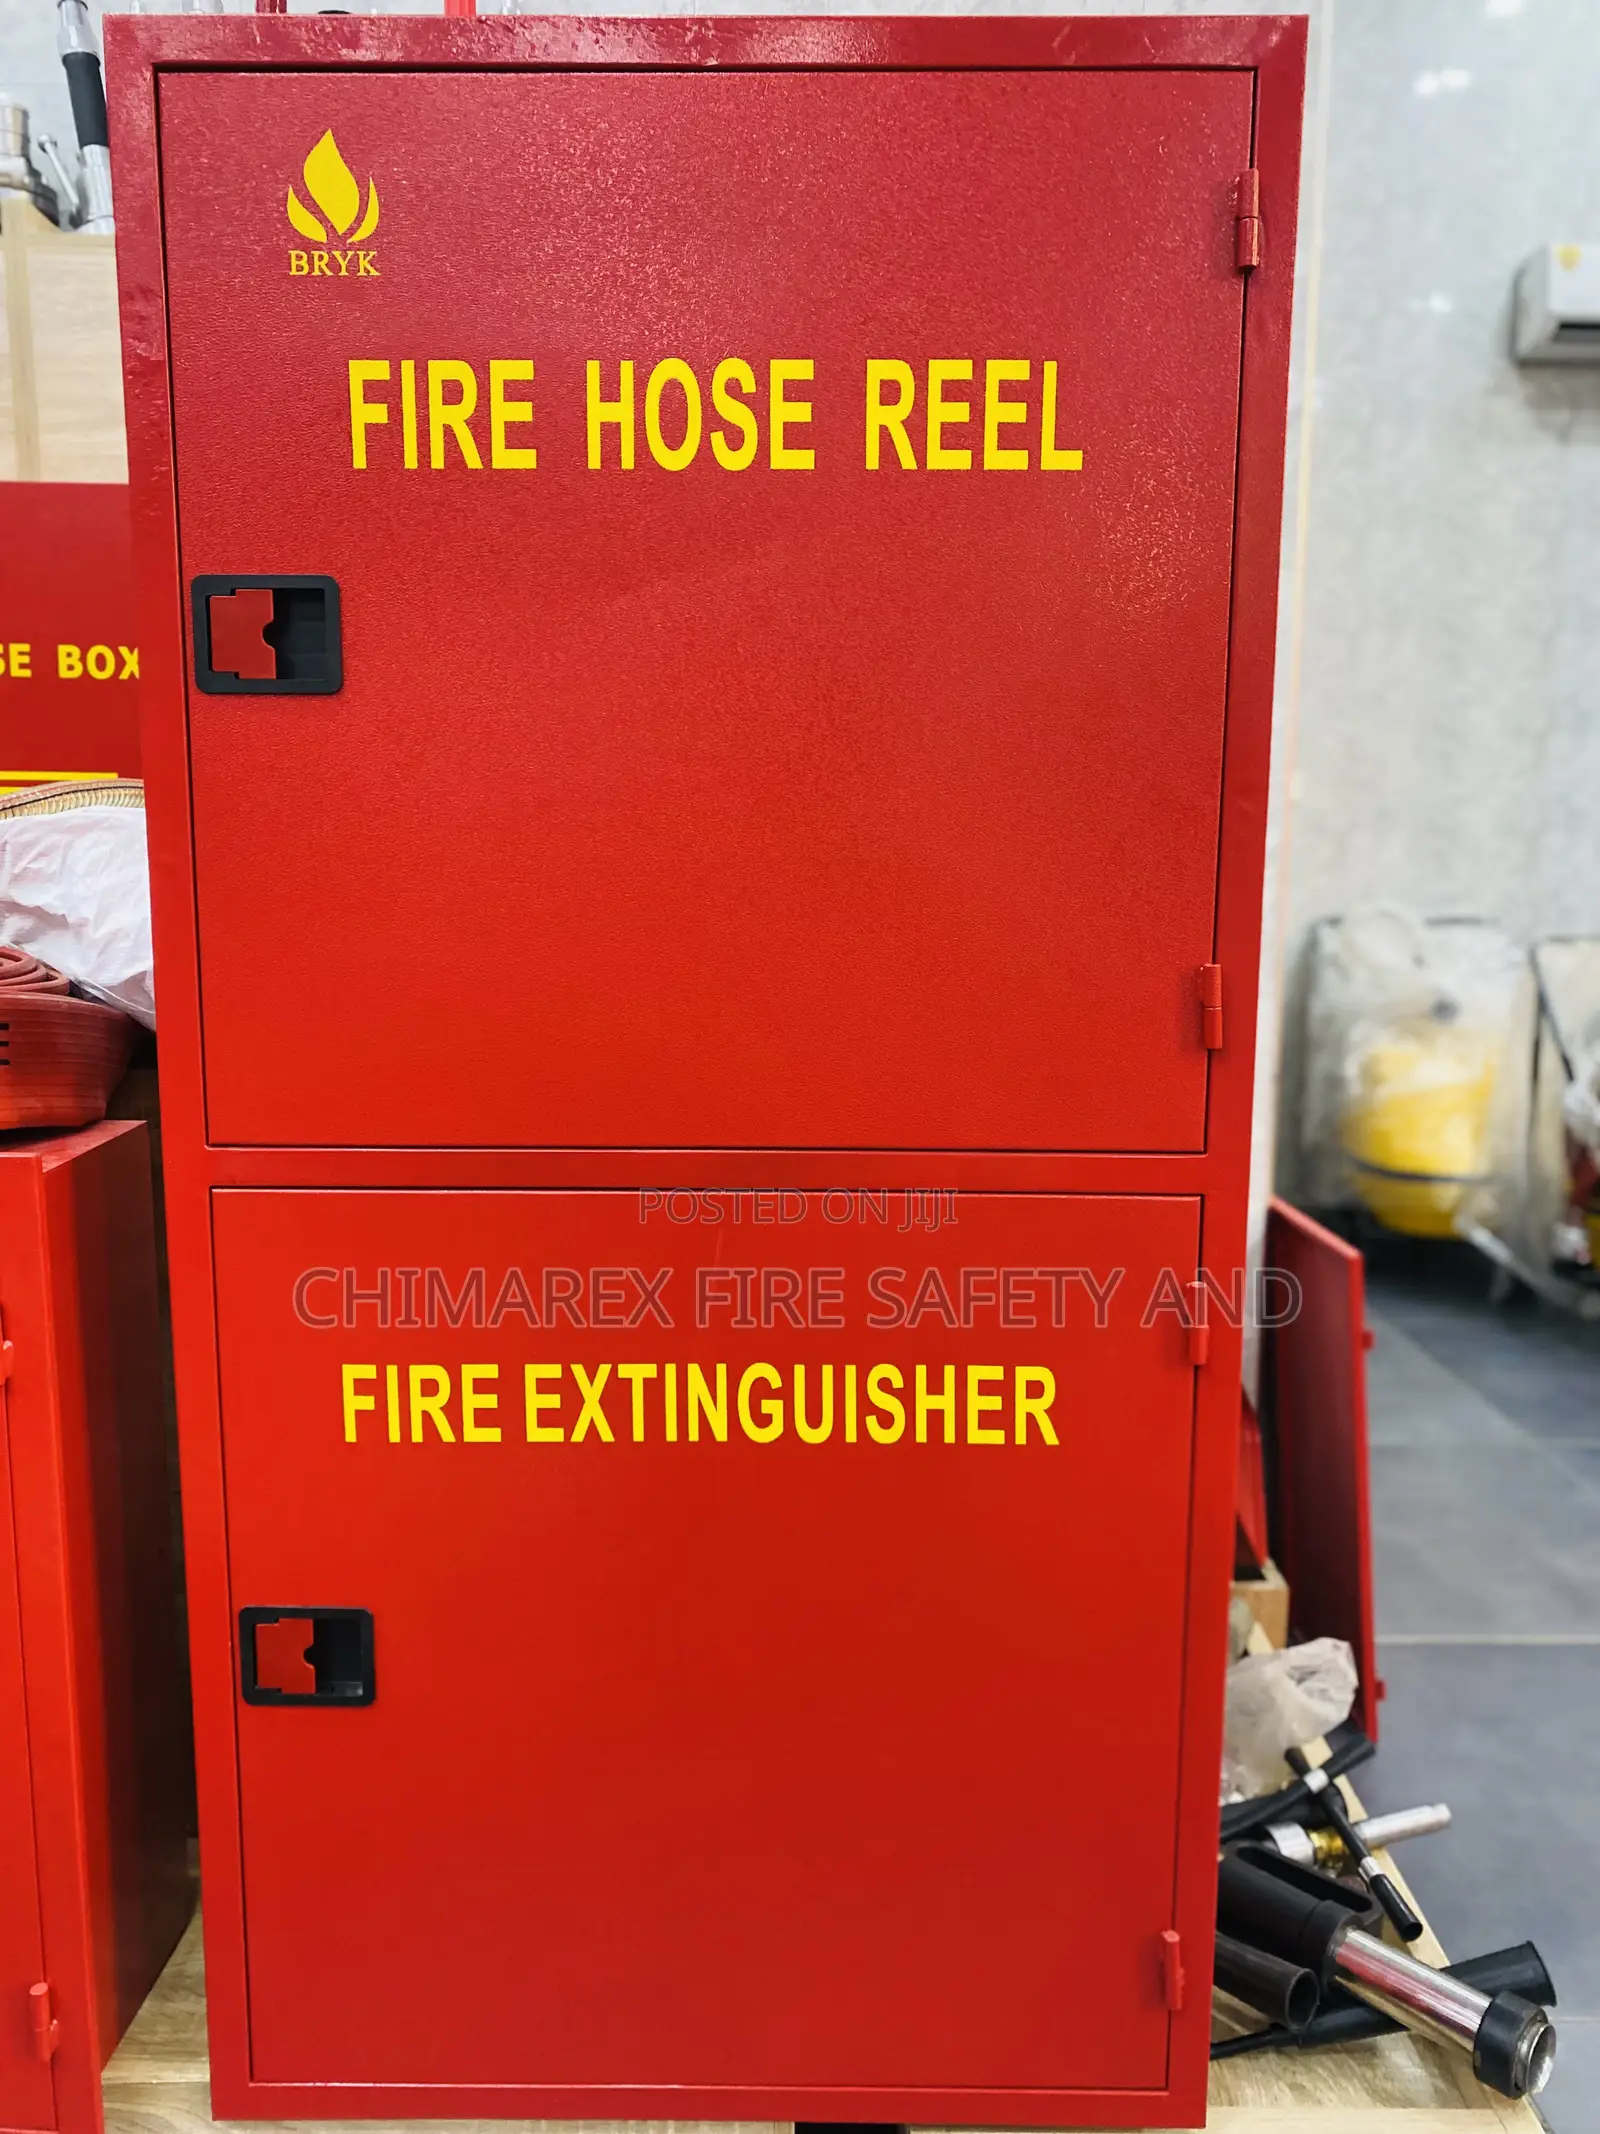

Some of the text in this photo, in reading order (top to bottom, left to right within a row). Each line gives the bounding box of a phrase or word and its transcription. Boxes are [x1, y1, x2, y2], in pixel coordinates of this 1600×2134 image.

[288, 250, 380, 277] BRYK
[348, 357, 1084, 473] FIRE HOSE REEL
[0, 642, 140, 680] E BOX
[342, 1361, 1060, 1446] FIRE EXTINGUISHER
